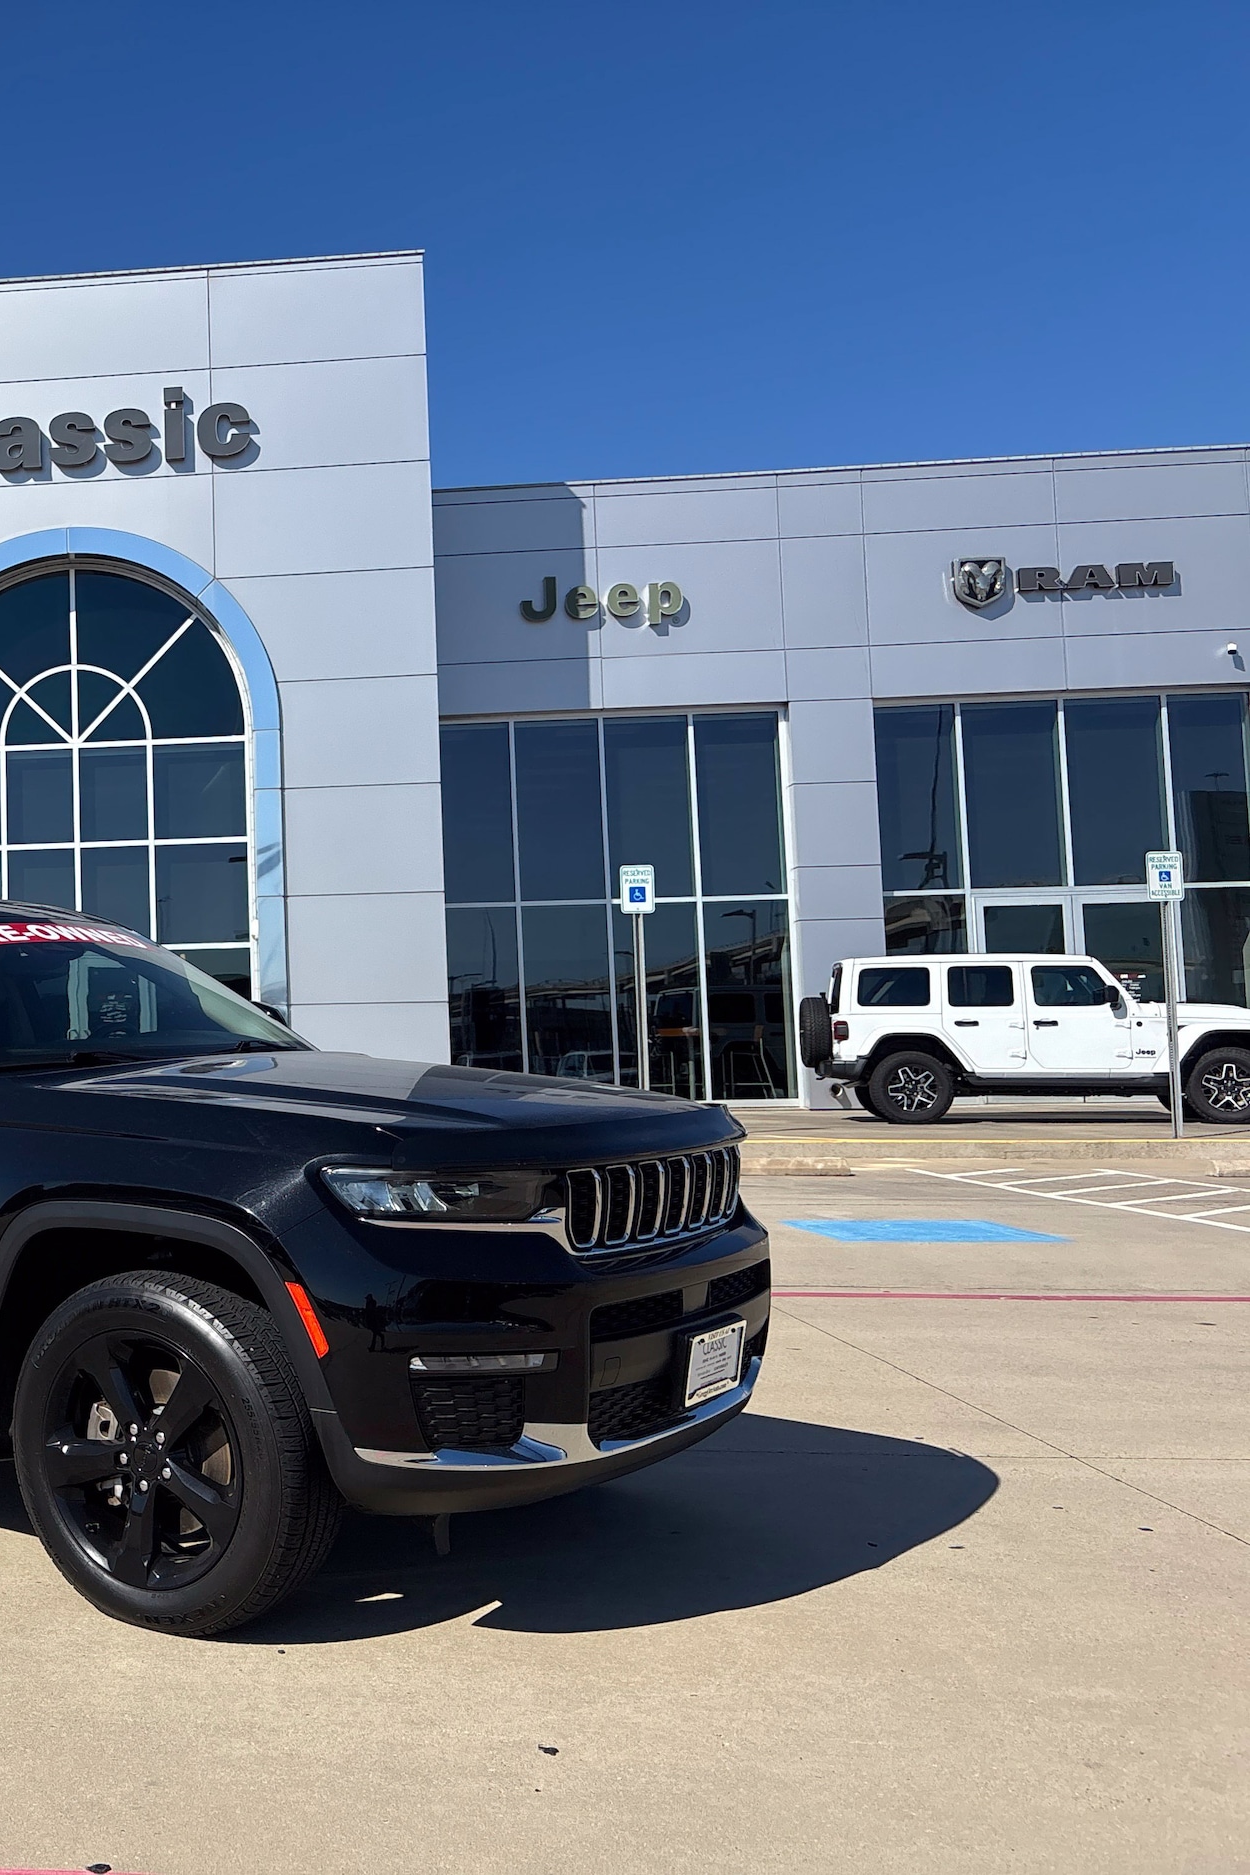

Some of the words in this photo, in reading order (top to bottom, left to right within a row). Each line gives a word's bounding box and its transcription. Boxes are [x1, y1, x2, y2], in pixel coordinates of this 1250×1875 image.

[1017, 561, 1175, 591] RAM
[520, 576, 684, 625] Jeep
[1149, 855, 1179, 863] RESERVED
[623, 869, 651, 877] RESERVED
[1135, 1048, 1156, 1056] Jeep
